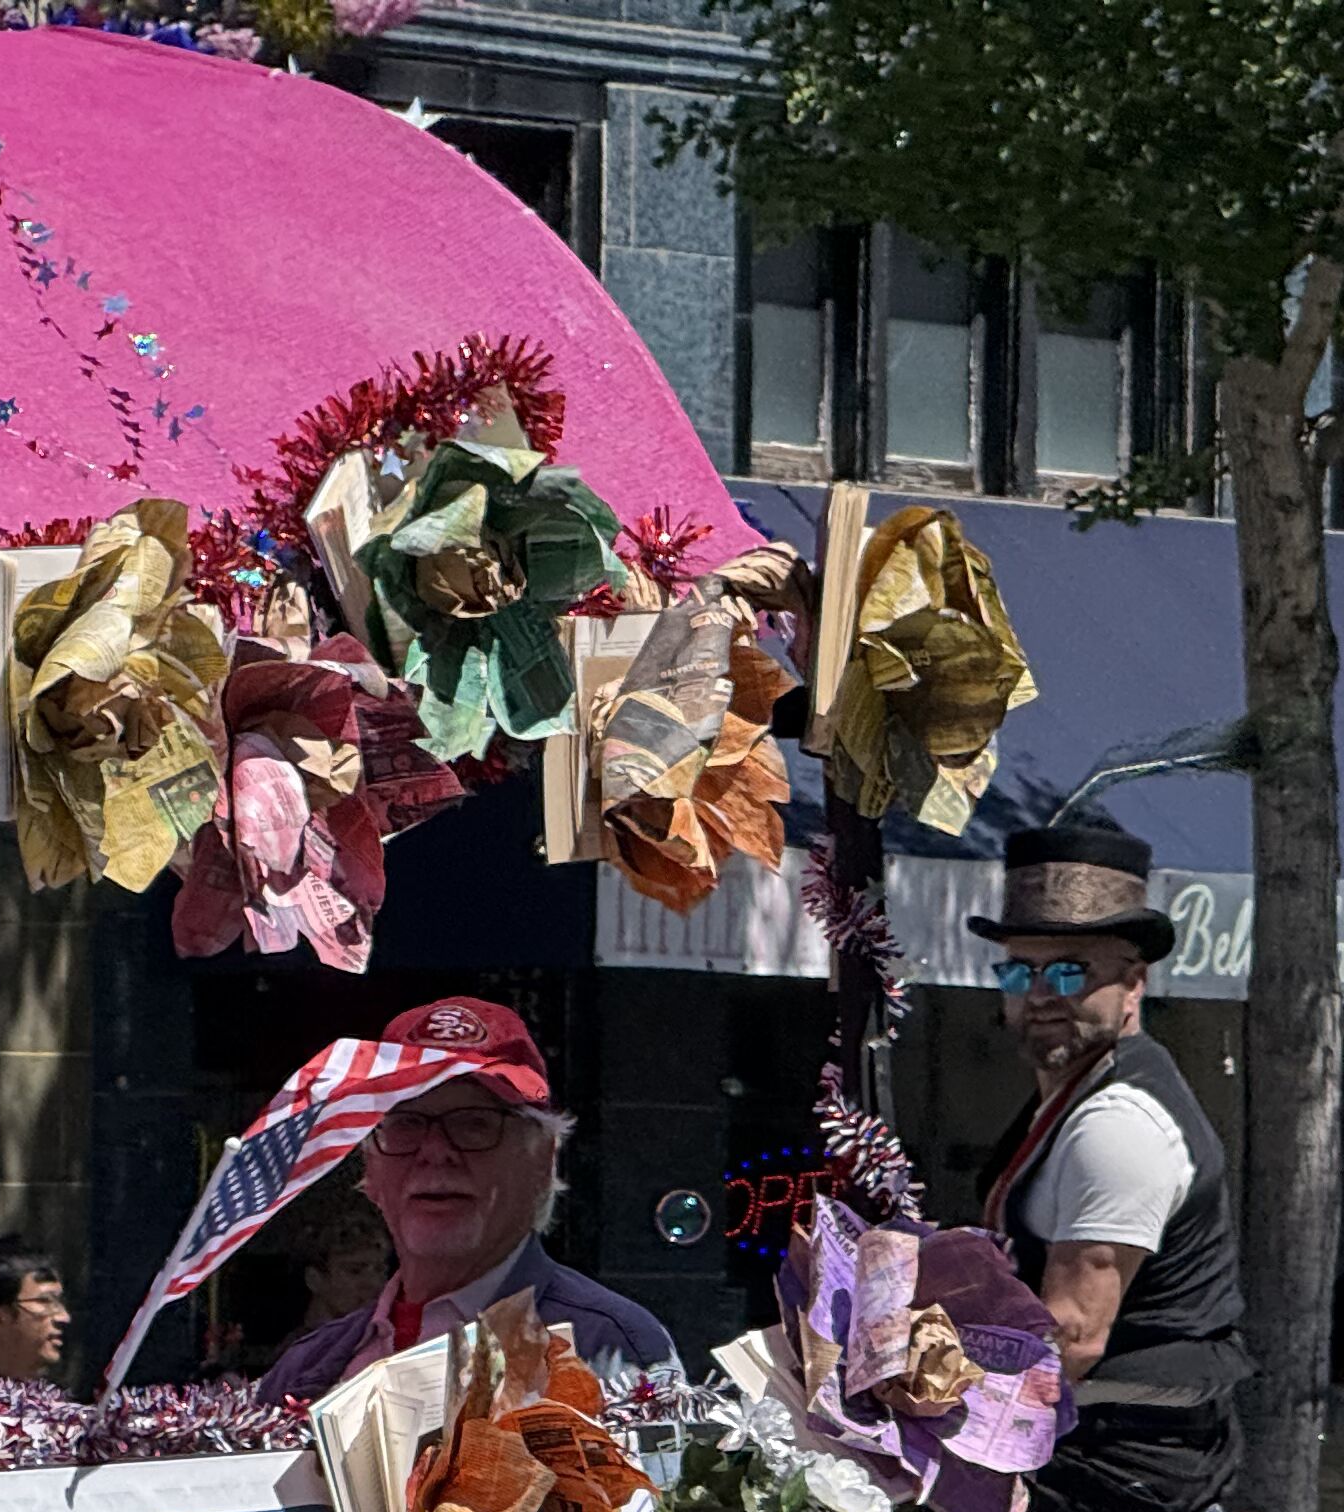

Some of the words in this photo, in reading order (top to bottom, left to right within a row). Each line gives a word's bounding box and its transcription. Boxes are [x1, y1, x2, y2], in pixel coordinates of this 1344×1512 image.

[1169, 884, 1254, 977] Bel
[724, 1170, 839, 1237] OPE
[820, 1213, 857, 1257] CLAIM
